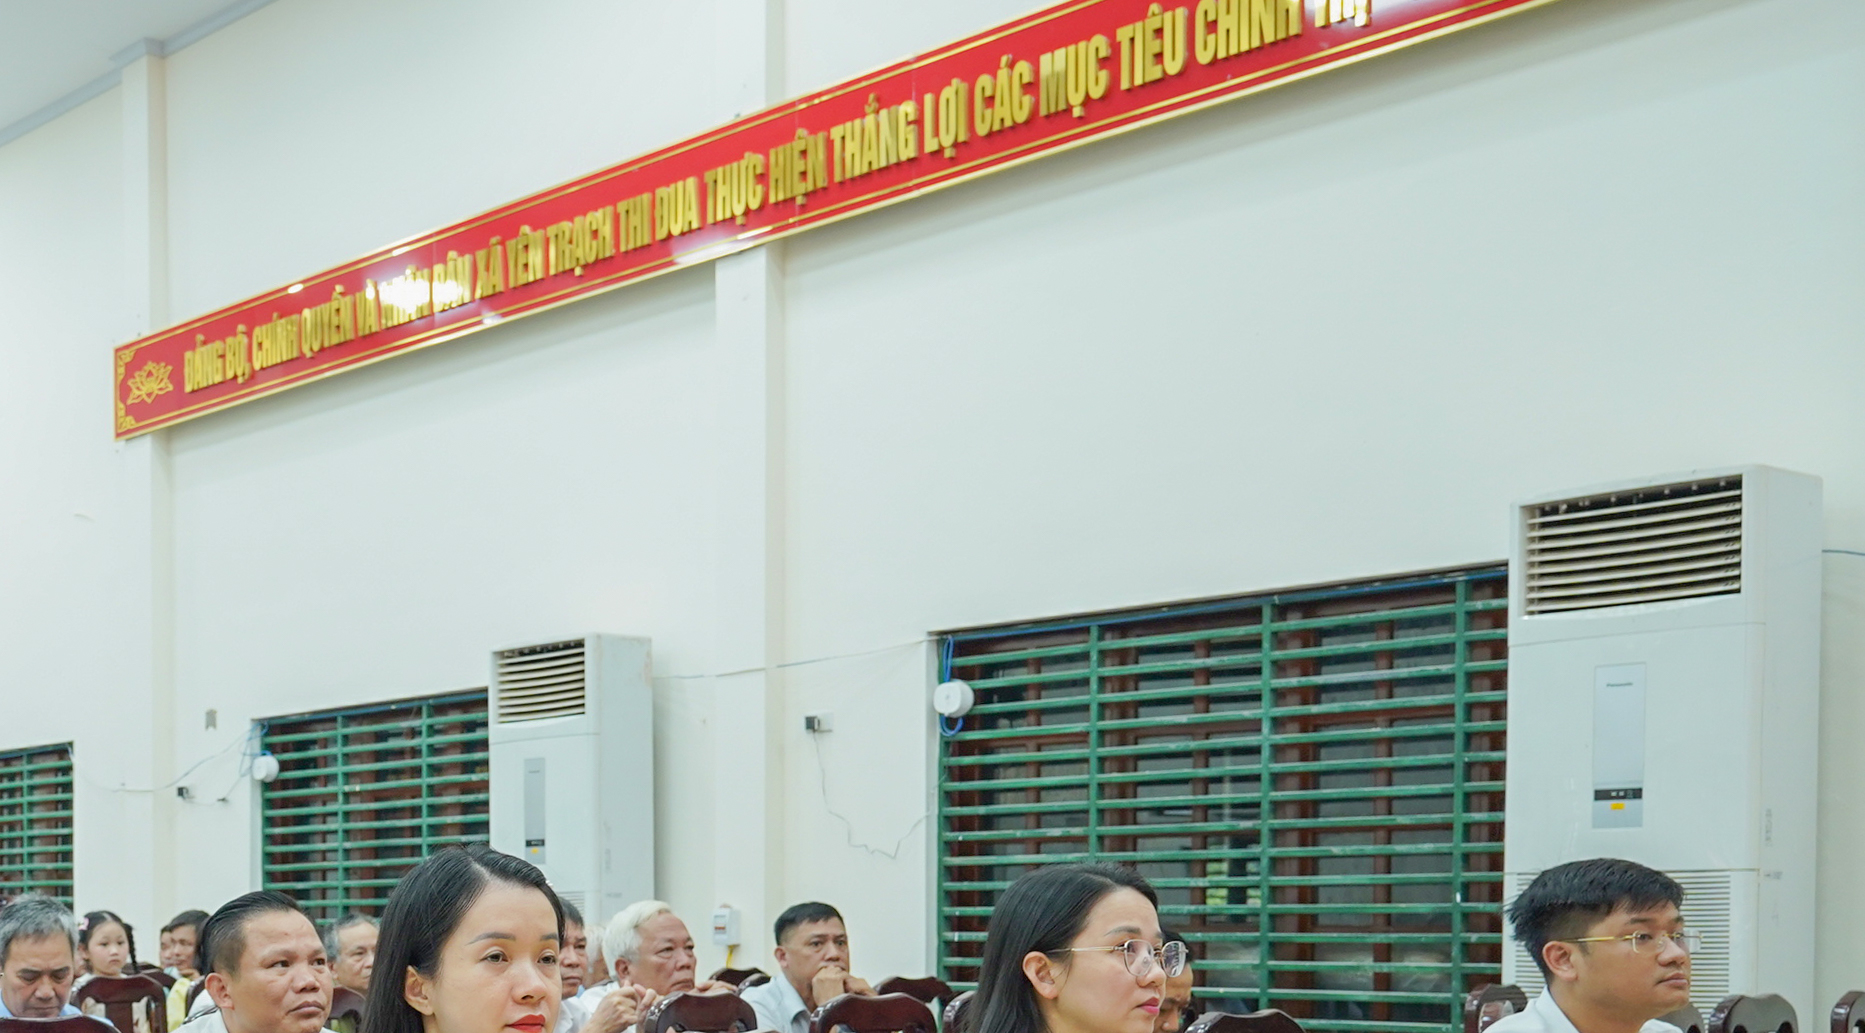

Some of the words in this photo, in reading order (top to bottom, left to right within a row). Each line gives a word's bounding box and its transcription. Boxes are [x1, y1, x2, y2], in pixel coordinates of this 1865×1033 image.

[184, 334, 225, 393] ĐẢNG
[252, 313, 301, 371] CHÍNH
[301, 284, 355, 359] QUYỀN
[355, 278, 379, 337] VÀ
[475, 235, 504, 299] XÃ
[506, 225, 545, 288] YÊN
[547, 205, 615, 277] TRẠCH
[617, 192, 652, 253] THI
[655, 176, 700, 241] ĐUA
[704, 151, 765, 226] THỰC
[769, 128, 828, 206] HIỆN
[830, 93, 919, 183] THẮNG
[924, 77, 968, 159] LỢI
[974, 54, 1034, 137] CÁC
[1039, 34, 1110, 118] MỤC
[1116, 2, 1187, 91] TIÊU
